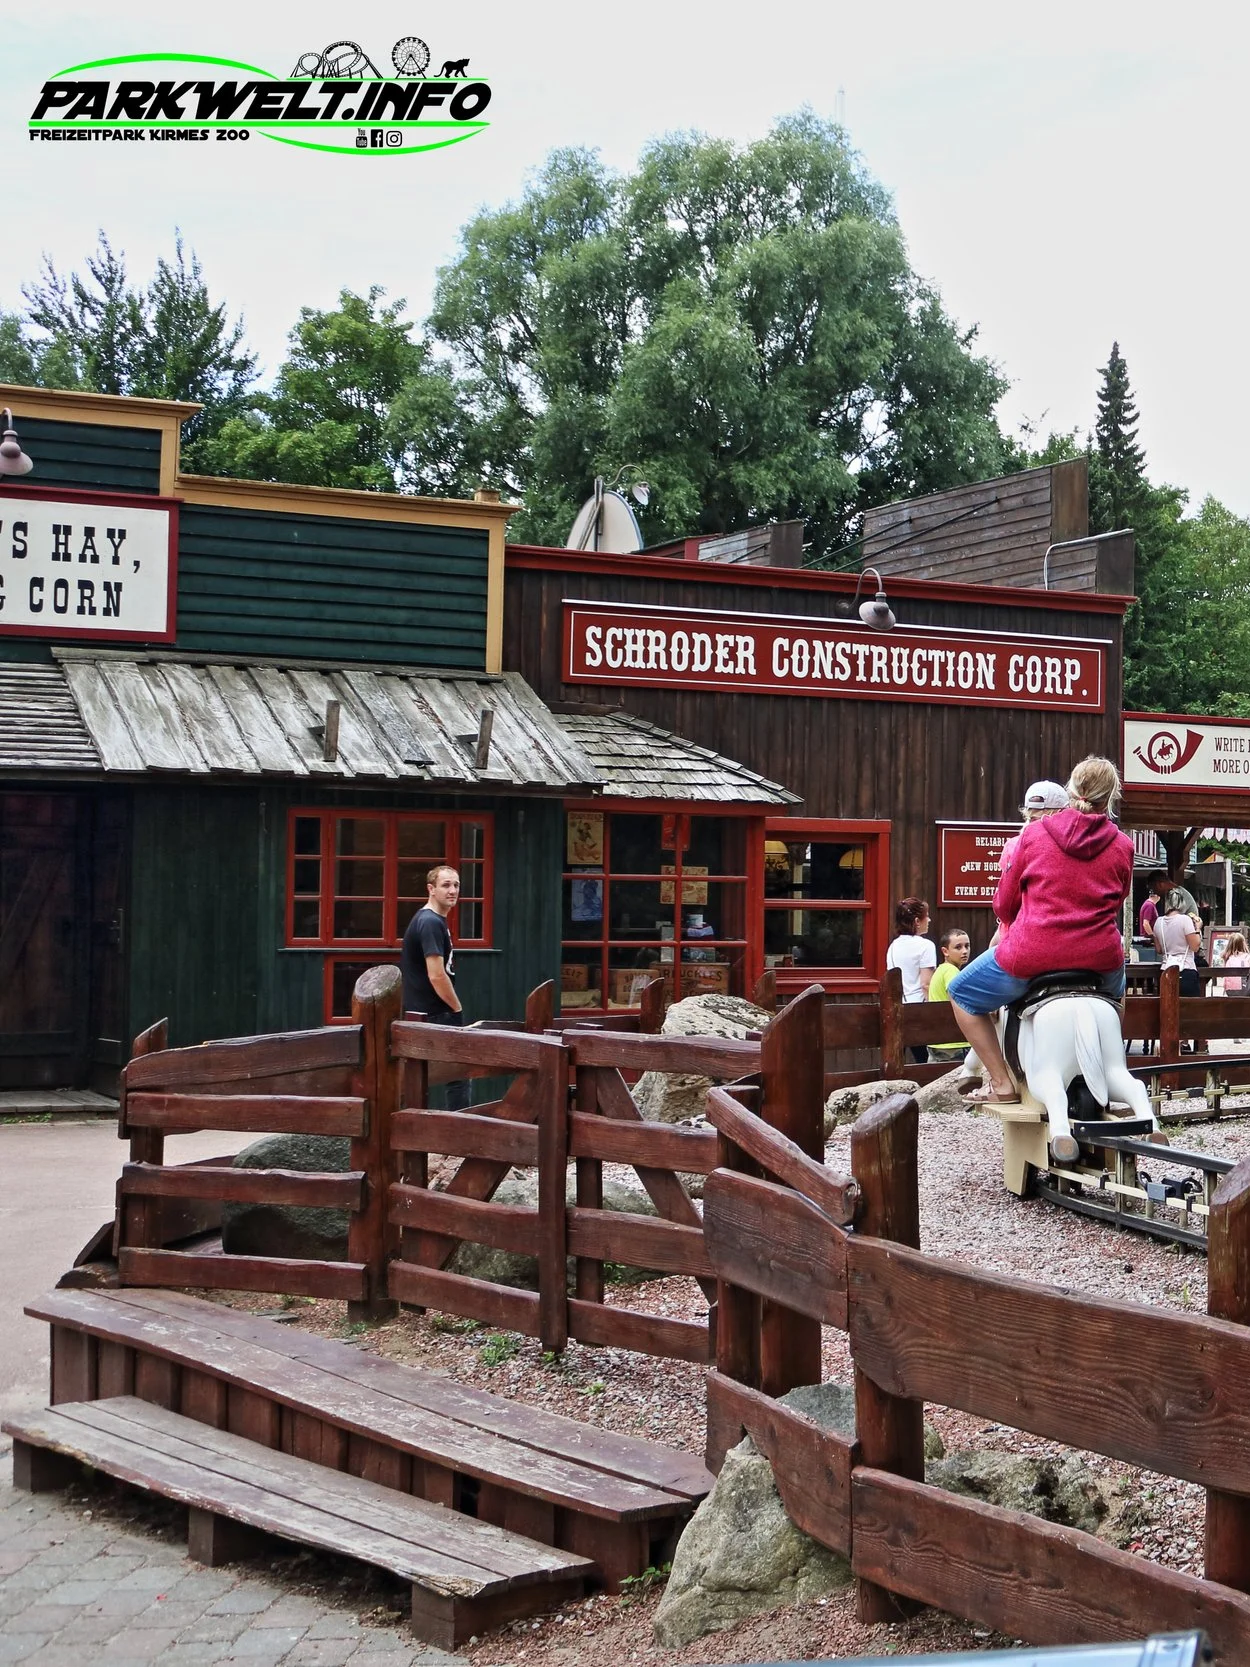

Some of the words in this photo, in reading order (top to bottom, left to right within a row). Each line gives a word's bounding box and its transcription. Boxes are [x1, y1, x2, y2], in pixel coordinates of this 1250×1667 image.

[52, 524, 140, 574] HAY,
[29, 576, 123, 617] CORN
[585, 625, 757, 676] SCHRODER
[772, 636, 996, 691] CONSTRUCTION
[1008, 653, 1088, 697] CORP.
[1214, 737, 1245, 753] WRITE
[1213, 758, 1241, 774] MORE
[954, 886, 979, 896] EVERY
